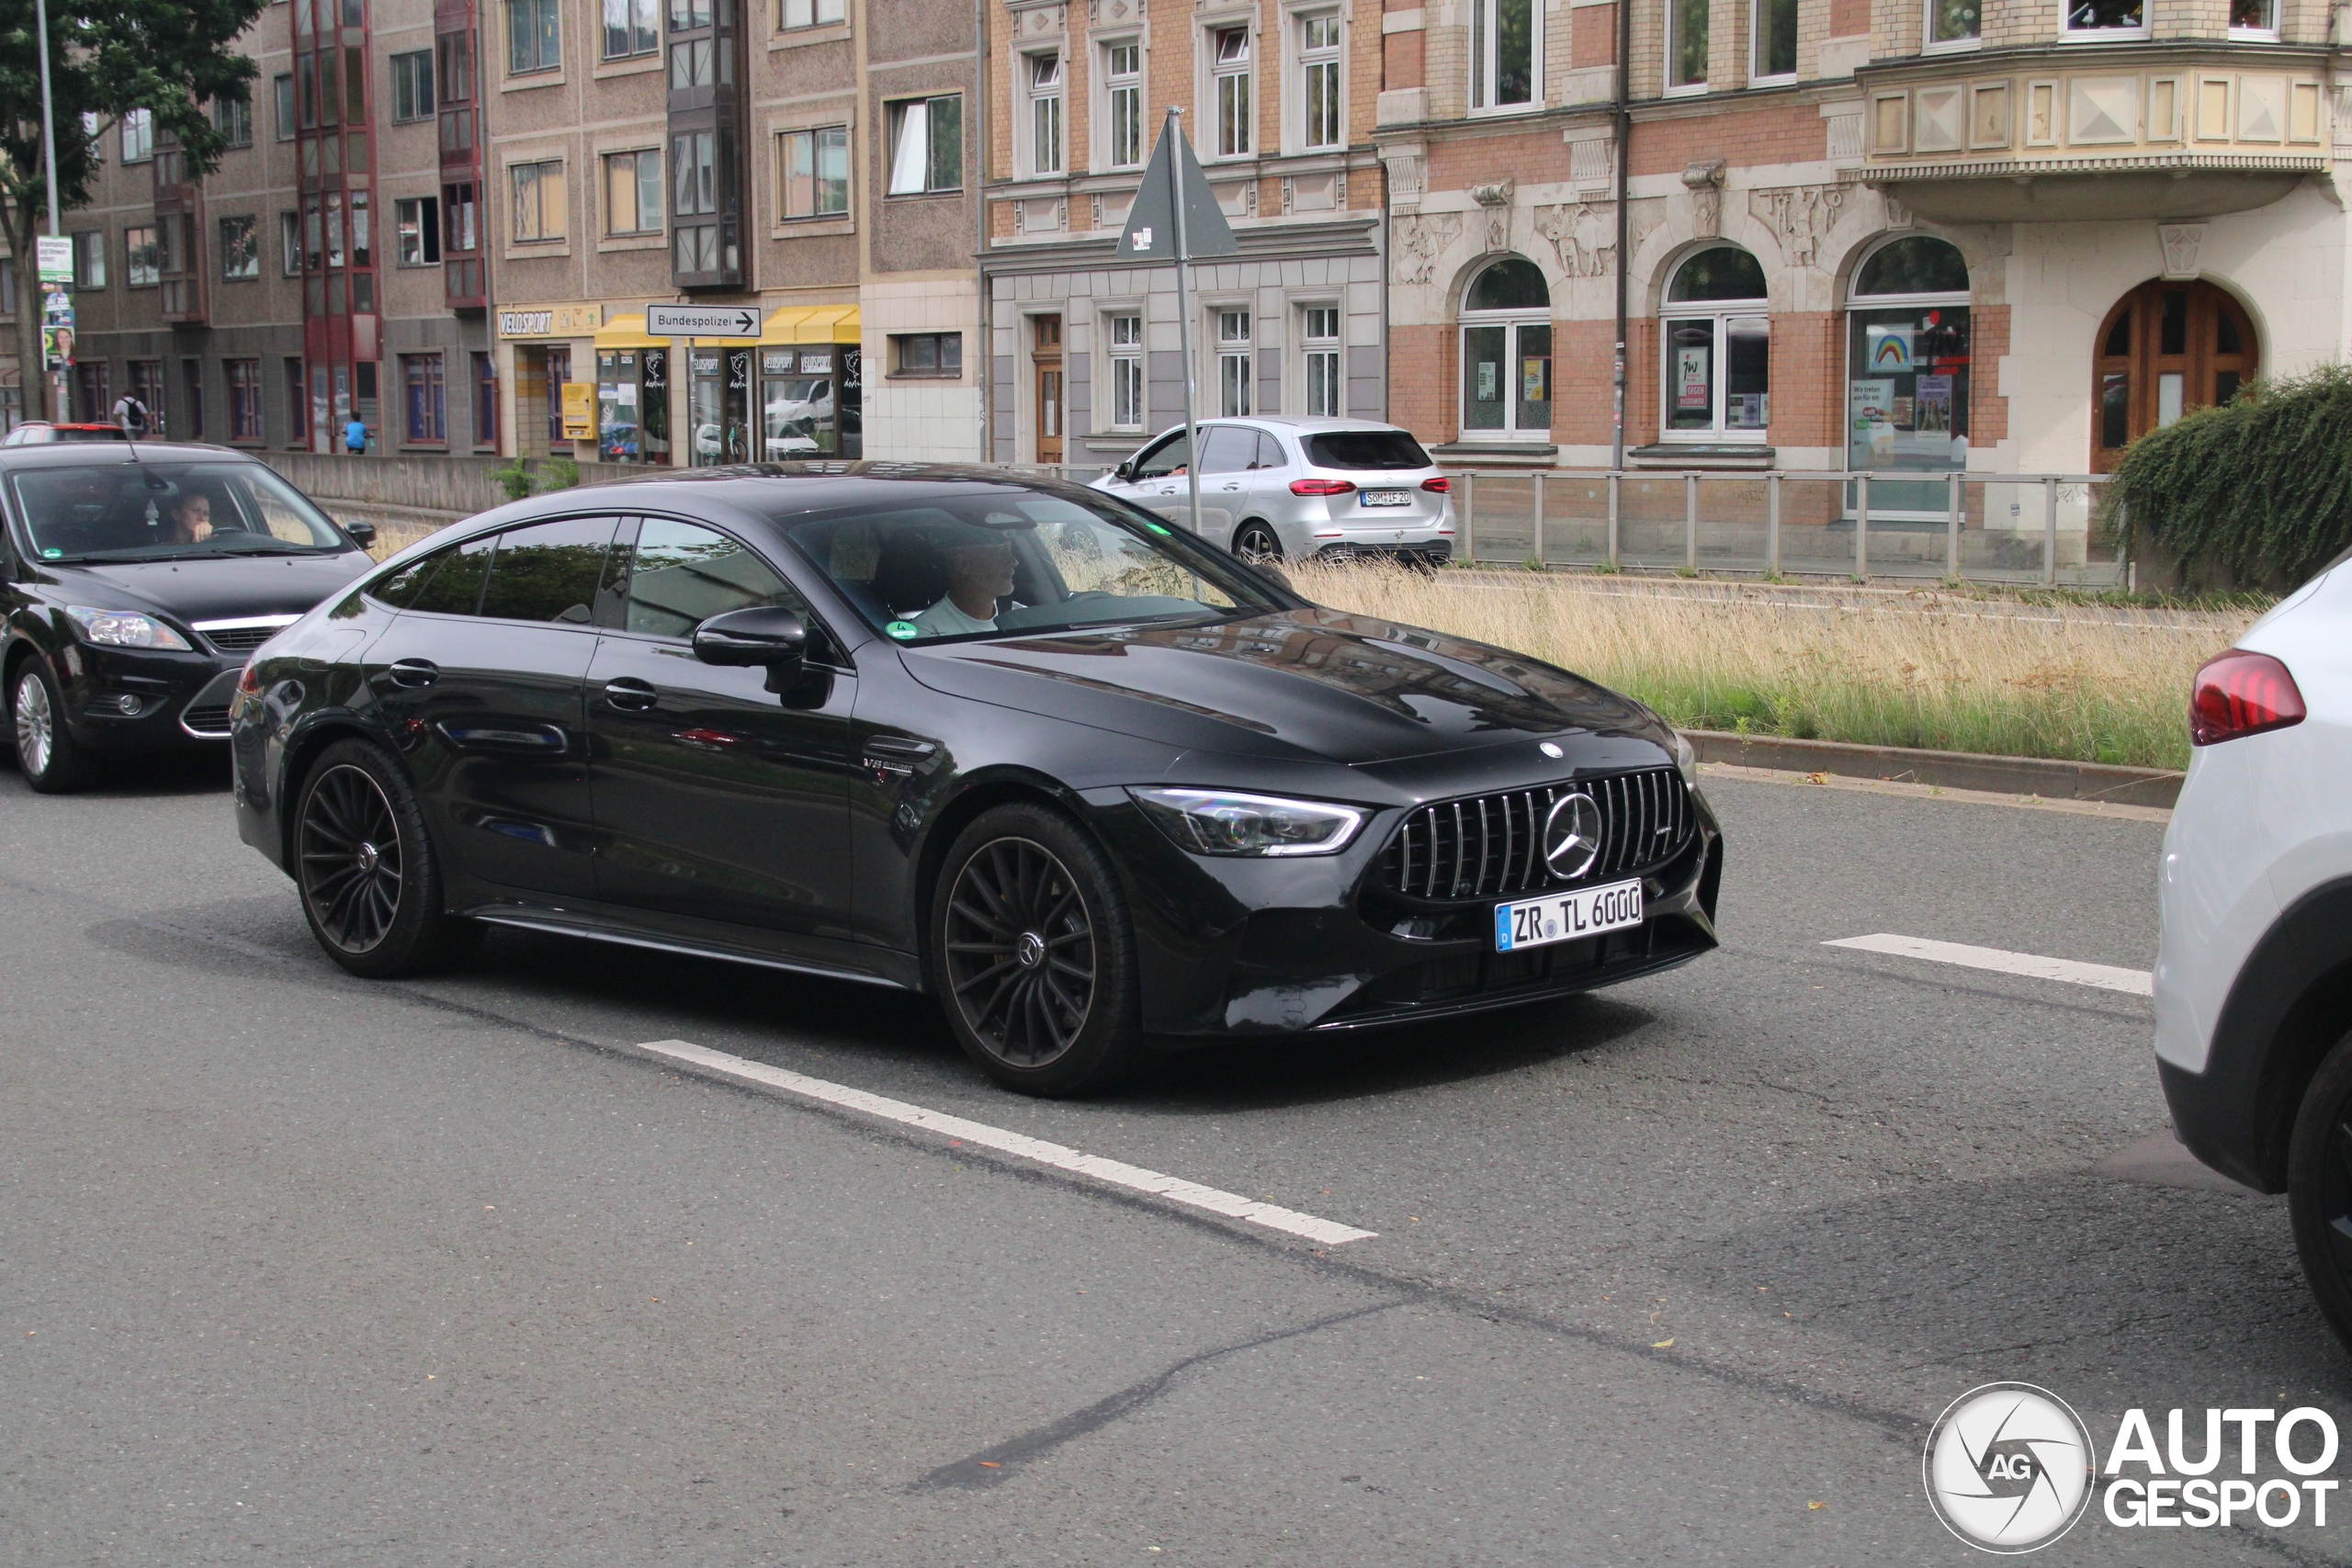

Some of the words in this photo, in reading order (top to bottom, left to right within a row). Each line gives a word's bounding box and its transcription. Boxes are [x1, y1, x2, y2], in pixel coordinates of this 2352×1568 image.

[500, 310, 552, 334] VELOSPORT
[658, 315, 732, 328] Bundespolizei
[694, 358, 719, 370] ELOSPORT
[763, 356, 793, 368] VELOSPORT
[801, 355, 831, 368] VELOSPORT
[1687, 386, 1704, 395] GEGEN
[1388, 492, 1397, 502] IF
[1399, 491, 1409, 502] 20
[897, 623, 907, 631] 4
[864, 758, 882, 769] V8
[883, 761, 913, 772] BITURBO
[1513, 905, 1544, 943] ZR
[1559, 898, 1587, 933] TL
[1592, 886, 1640, 927] 6000
